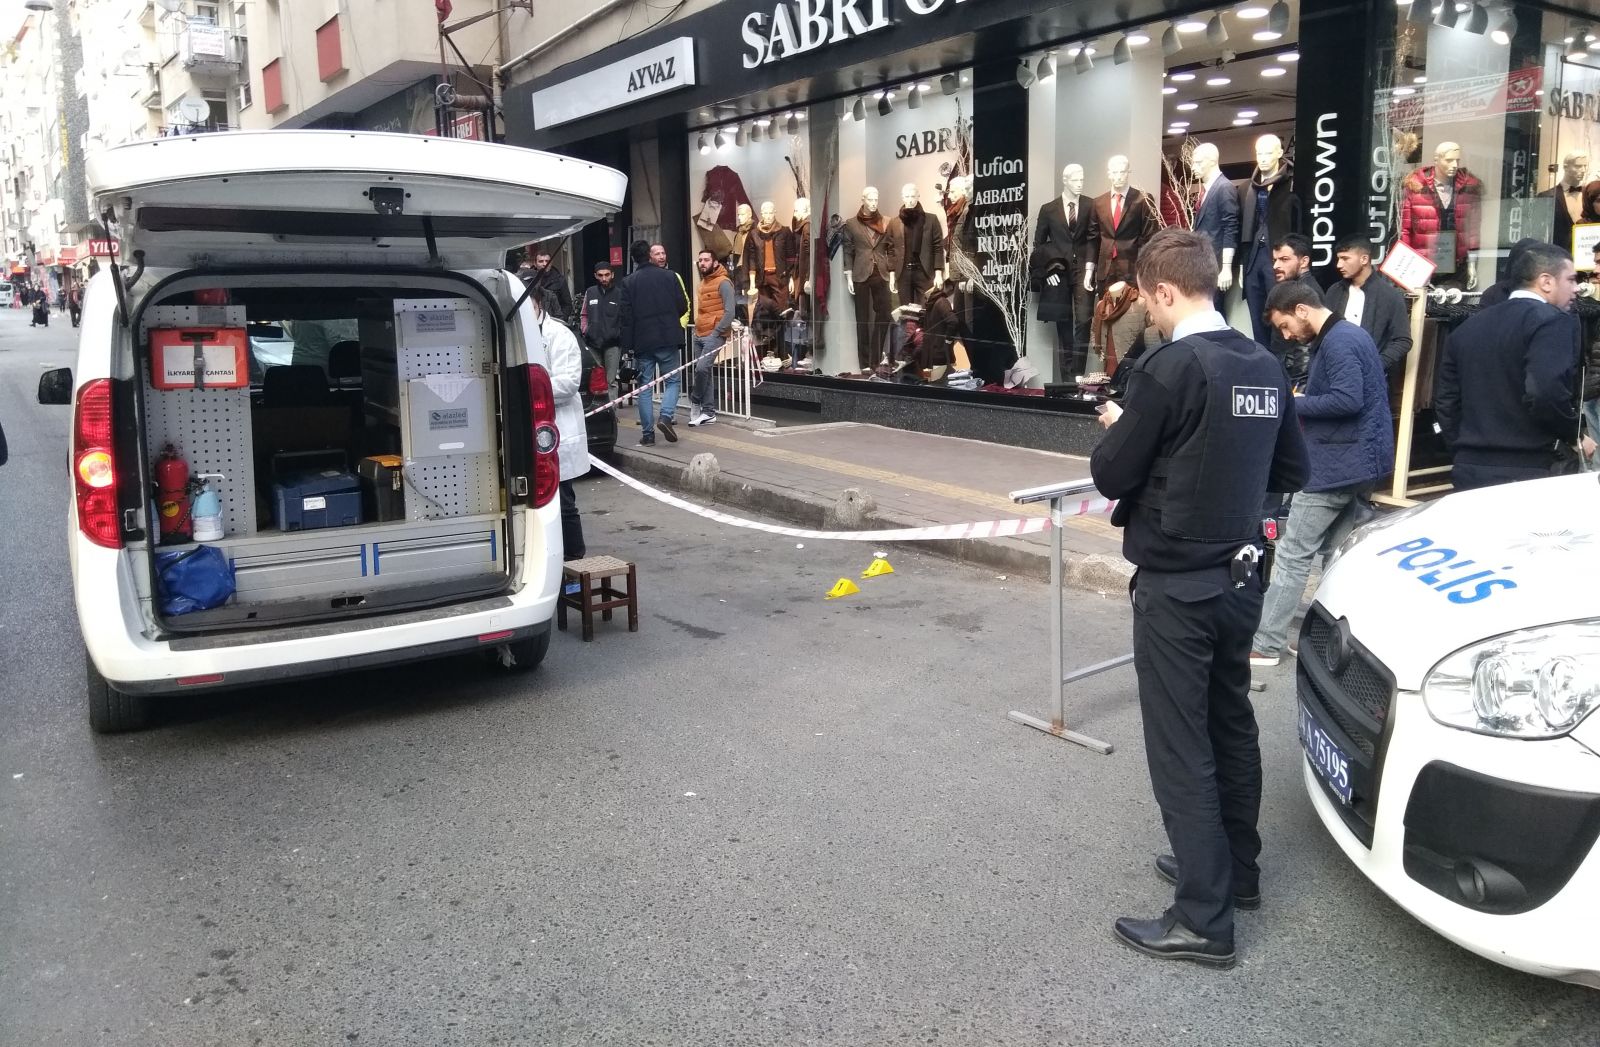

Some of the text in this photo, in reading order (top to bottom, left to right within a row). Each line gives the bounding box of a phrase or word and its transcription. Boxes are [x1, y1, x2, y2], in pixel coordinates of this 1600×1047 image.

[627, 56, 676, 93] AYVAZ
[895, 127, 962, 160] SABR
[974, 155, 1024, 178] Lufian
[1310, 112, 1338, 267] uptown
[1368, 145, 1391, 266] Lufian
[974, 213, 1023, 229] uptown
[977, 233, 1019, 253] RUBA
[1236, 390, 1276, 415] POLİS
[1376, 537, 1518, 604] POLİS
[1314, 729, 1348, 788] 75195
